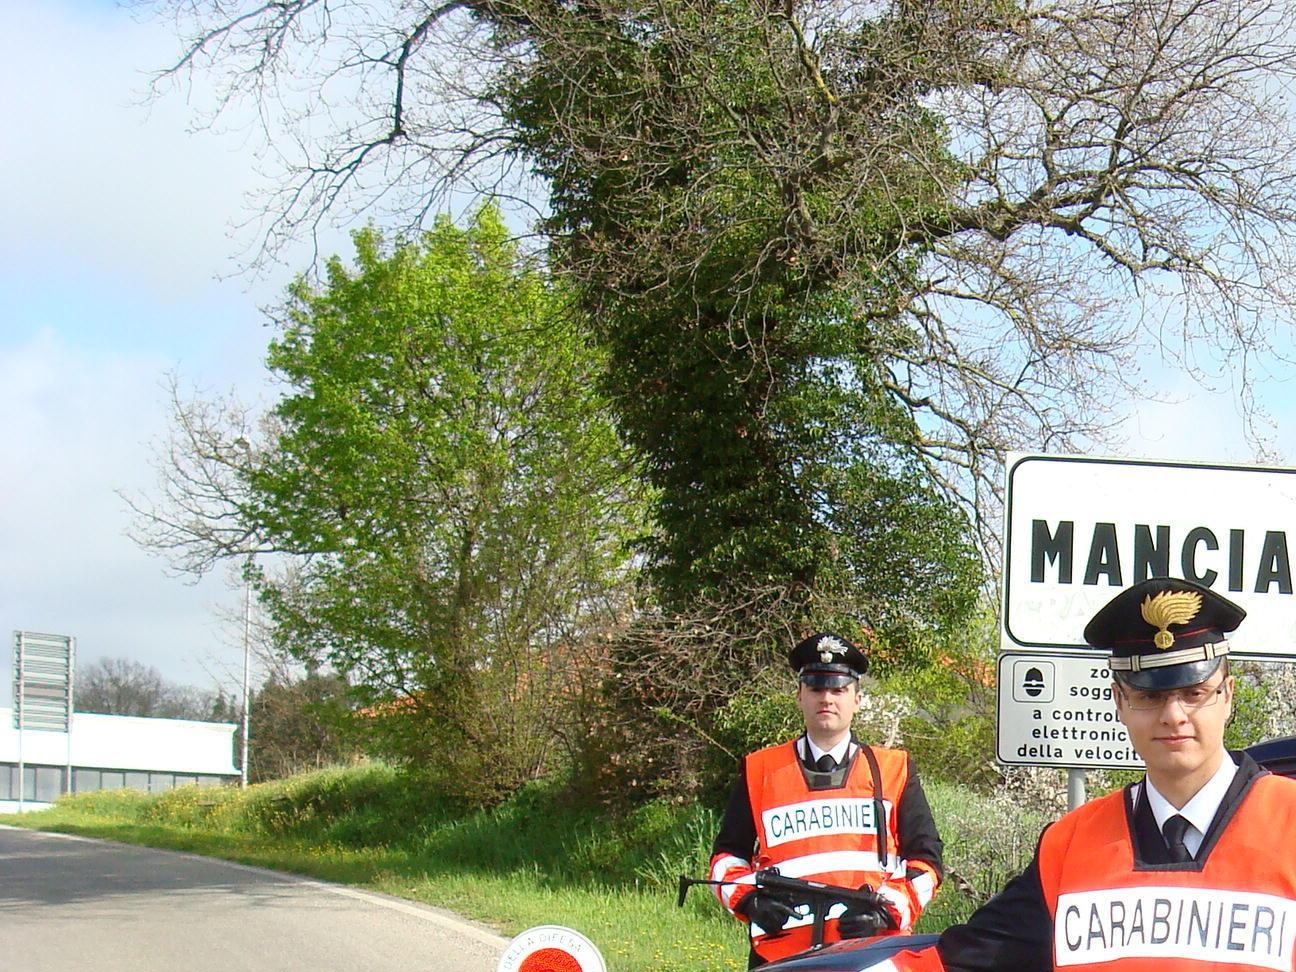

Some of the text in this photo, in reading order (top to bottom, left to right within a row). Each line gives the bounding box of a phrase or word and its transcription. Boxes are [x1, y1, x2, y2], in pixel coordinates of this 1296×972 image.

[1033, 709, 1042, 720] a
[1032, 725, 1127, 742] elettronic
[1017, 744, 1142, 761] della velocit
[1064, 898, 1287, 957] CARABINIERI
